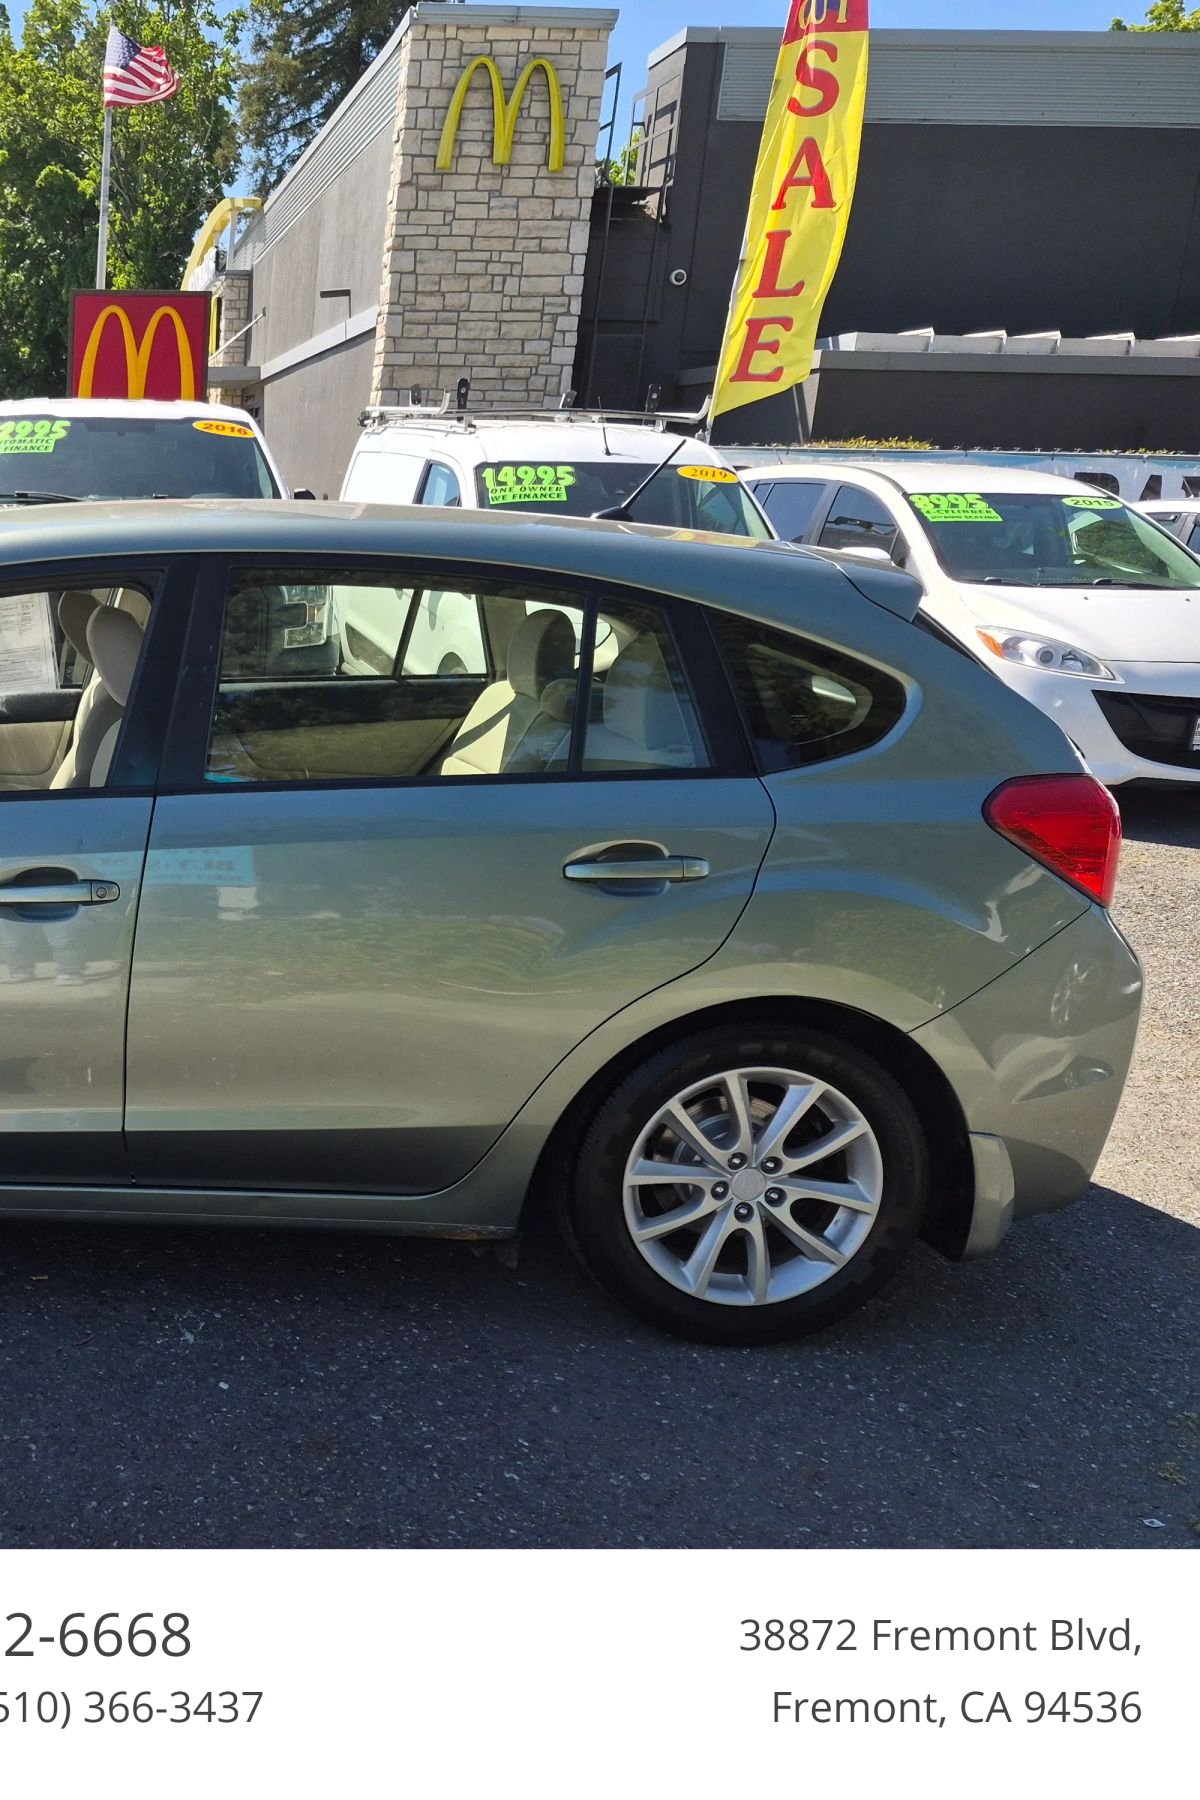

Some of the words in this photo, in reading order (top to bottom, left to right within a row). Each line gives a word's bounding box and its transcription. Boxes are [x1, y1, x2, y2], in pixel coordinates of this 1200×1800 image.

[729, 39, 841, 383] SALE
[202, 423, 248, 435] 2016
[3, 444, 52, 452] FINANCE
[481, 465, 576, 488] 14995
[690, 468, 728, 479] 2019
[490, 486, 514, 494] ONE
[490, 494, 508, 502] WE
[512, 492, 564, 500] FINANCE
[909, 493, 989, 510] 8995
[1070, 498, 1115, 507] 2015
